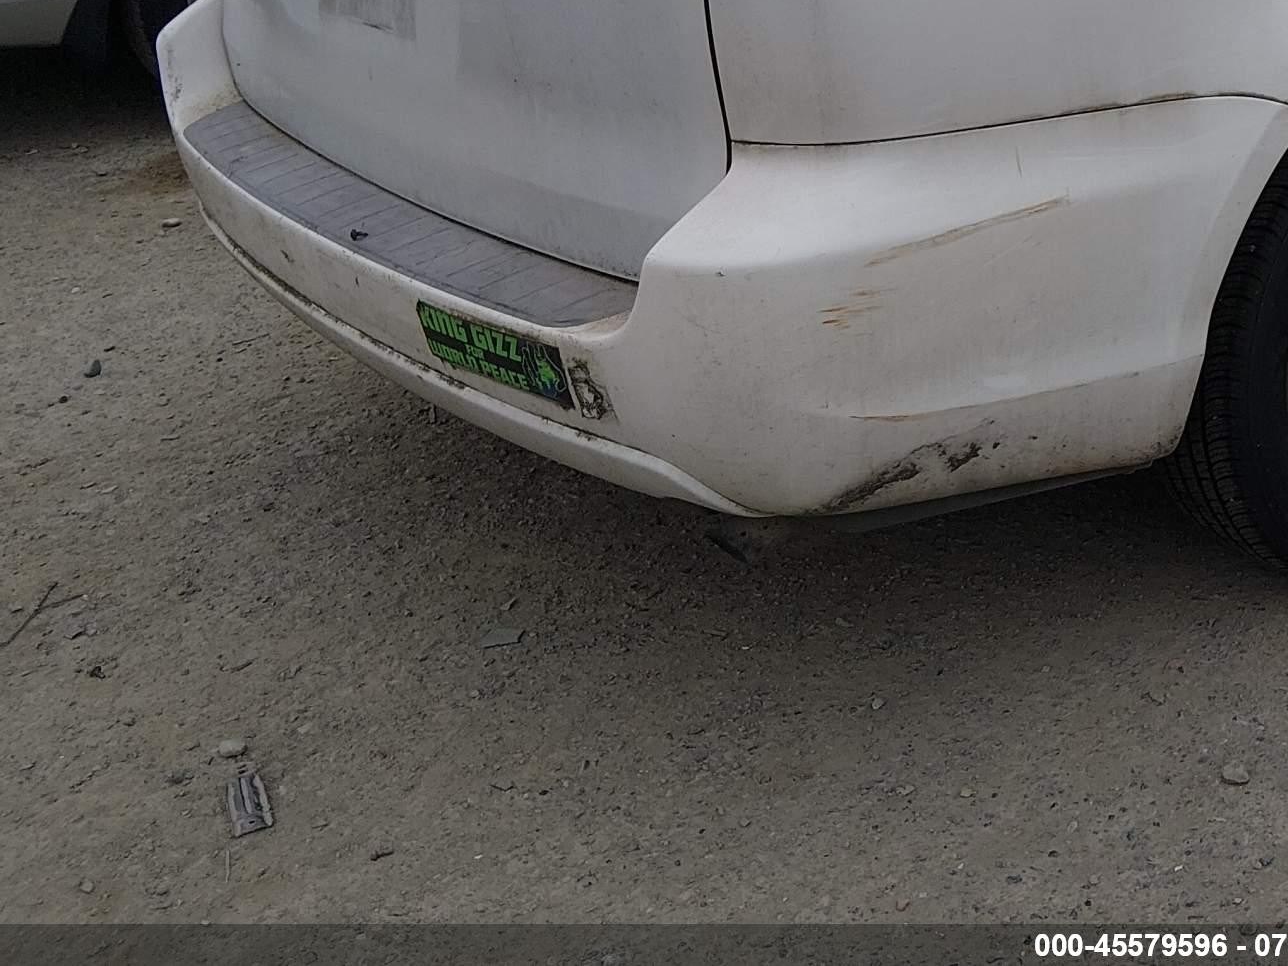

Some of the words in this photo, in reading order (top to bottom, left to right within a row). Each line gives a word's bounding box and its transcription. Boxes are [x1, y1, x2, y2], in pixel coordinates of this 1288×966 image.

[419, 303, 467, 343] KING
[470, 323, 522, 363] GIZZ
[465, 344, 484, 359] FOR
[428, 338, 480, 373] WORLD
[479, 360, 530, 391] PEACE
